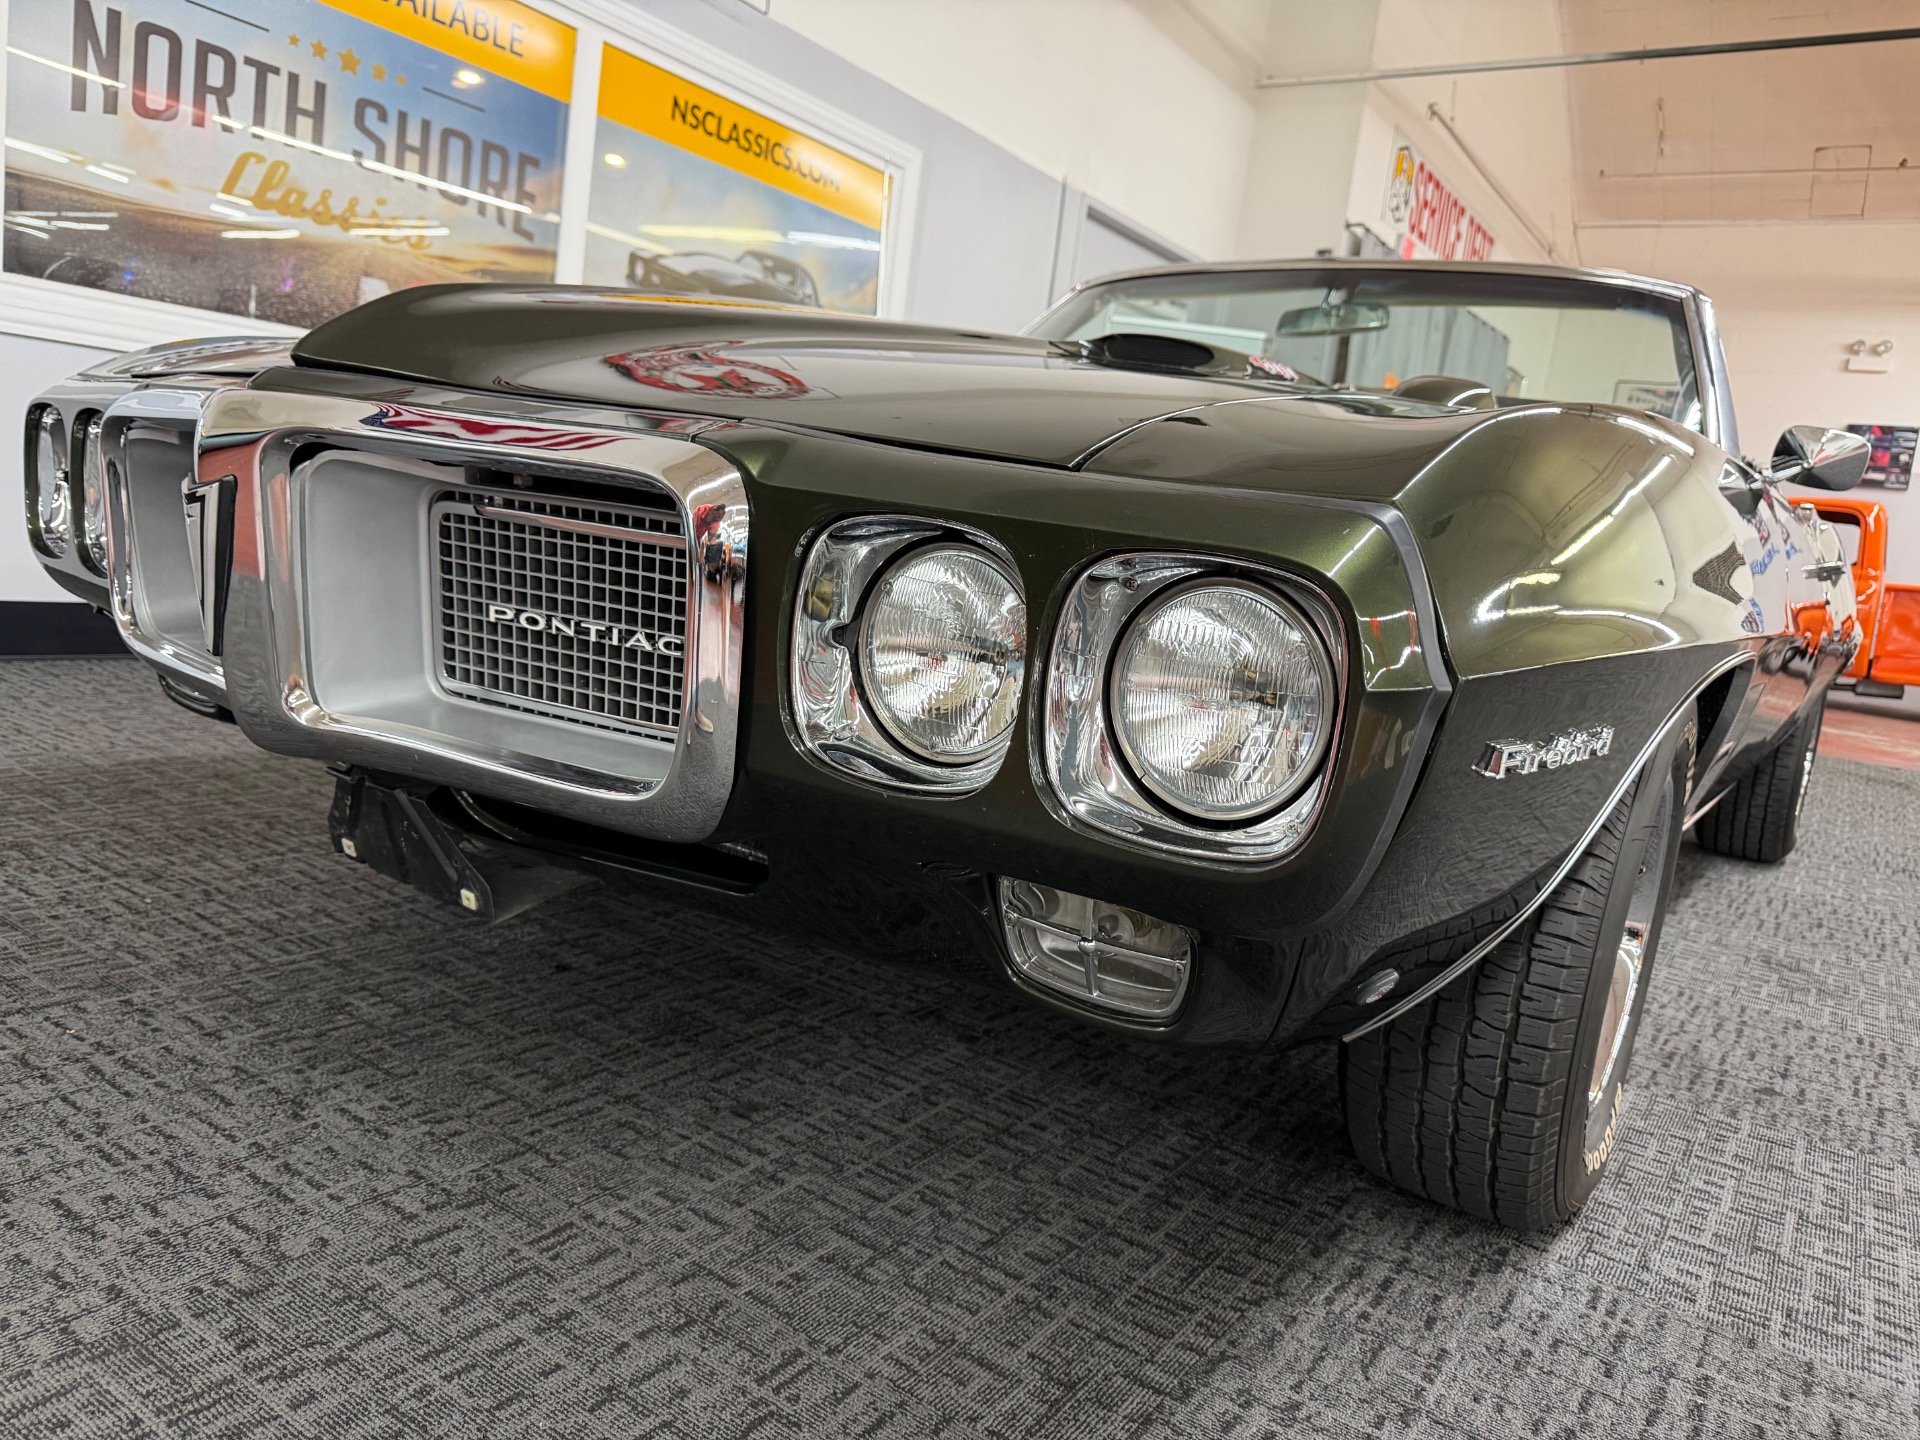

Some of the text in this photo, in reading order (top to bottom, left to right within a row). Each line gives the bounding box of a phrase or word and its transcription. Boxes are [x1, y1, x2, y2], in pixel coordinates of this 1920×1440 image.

[70, 0, 541, 243] NORTH SHORE
[671, 94, 842, 193] NSCLASSICS.COM
[220, 150, 433, 250] Classics
[488, 604, 684, 656] PONTIAC
[1472, 723, 1616, 779] Firebird
